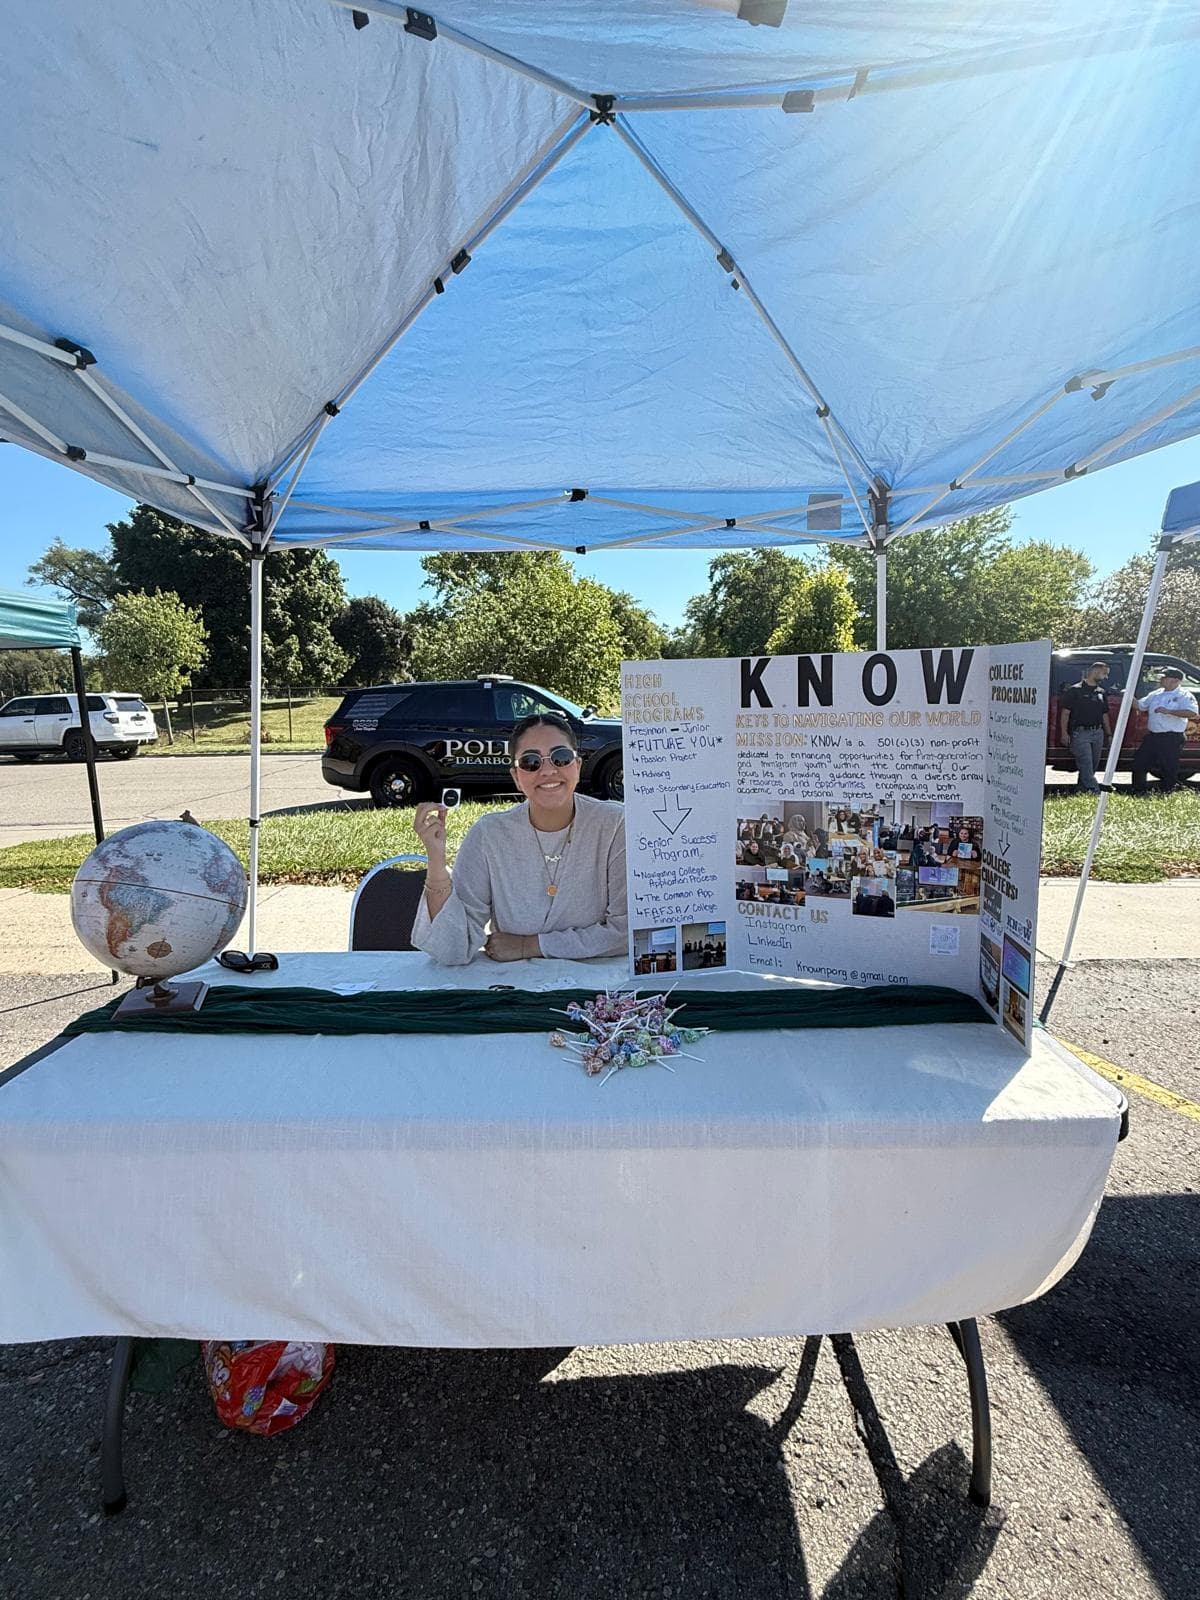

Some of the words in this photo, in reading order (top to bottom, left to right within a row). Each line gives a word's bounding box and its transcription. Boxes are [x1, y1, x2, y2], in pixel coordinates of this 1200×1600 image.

[989, 663, 1024, 681] COLLEGE
[625, 673, 662, 689] HIGH
[624, 692, 680, 708] SCHOOL
[991, 685, 1037, 705] PROGRAMS
[625, 706, 705, 724] PROGRAMS
[736, 713, 769, 729] KEYS
[772, 713, 789, 728] TO
[793, 711, 884, 729] NAVIGATING
[889, 711, 921, 728] OUR
[926, 710, 981, 727] WORLD
[680, 722, 710, 734] Junior
[443, 739, 512, 758] POLI
[736, 732, 808, 747] MISSION:
[811, 734, 841, 748] KNOW
[845, 738, 852, 747] is
[878, 738, 925, 748] 501(c)(3)
[930, 738, 980, 749] non-profit
[455, 756, 512, 765] DEARBO
[640, 754, 666, 763] Passion
[669, 752, 697, 762] Project
[738, 750, 769, 759] dedicated
[775, 751, 784, 760] to
[790, 752, 831, 763] enhancing
[839, 752, 894, 762] opportunities
[900, 751, 914, 760] for
[737, 760, 752, 768] and
[804, 761, 827, 771] youth
[834, 761, 860, 769] within
[870, 762, 888, 770] the
[951, 762, 970, 772] Our
[737, 767, 759, 778] focus
[828, 771, 866, 782] guidance
[869, 770, 903, 784] through
[924, 772, 958, 781] diverse
[960, 773, 984, 783] array
[695, 781, 731, 791] Education
[736, 778, 746, 786] of
[792, 779, 810, 788] and
[875, 781, 929, 794] encompassing
[936, 783, 957, 792] both
[736, 787, 771, 795] academic
[777, 788, 795, 796] and
[801, 790, 834, 800] personal
[884, 791, 895, 800] of
[638, 836, 673, 851] Senior
[681, 834, 717, 844] Success
[653, 847, 700, 861] Program
[982, 848, 1012, 879] COLLEGE
[641, 869, 676, 879] Navigating
[678, 866, 706, 877] College
[689, 874, 718, 883] Process
[643, 893, 661, 902] The
[663, 890, 693, 901] Common
[697, 888, 714, 899] App
[692, 902, 718, 914] College
[737, 901, 800, 920] CONTACT
[810, 908, 829, 924] US
[653, 914, 695, 924] Financing
[744, 916, 808, 935] Instagram
[747, 933, 793, 950] LinkedIn
[749, 953, 784, 969] Email:
